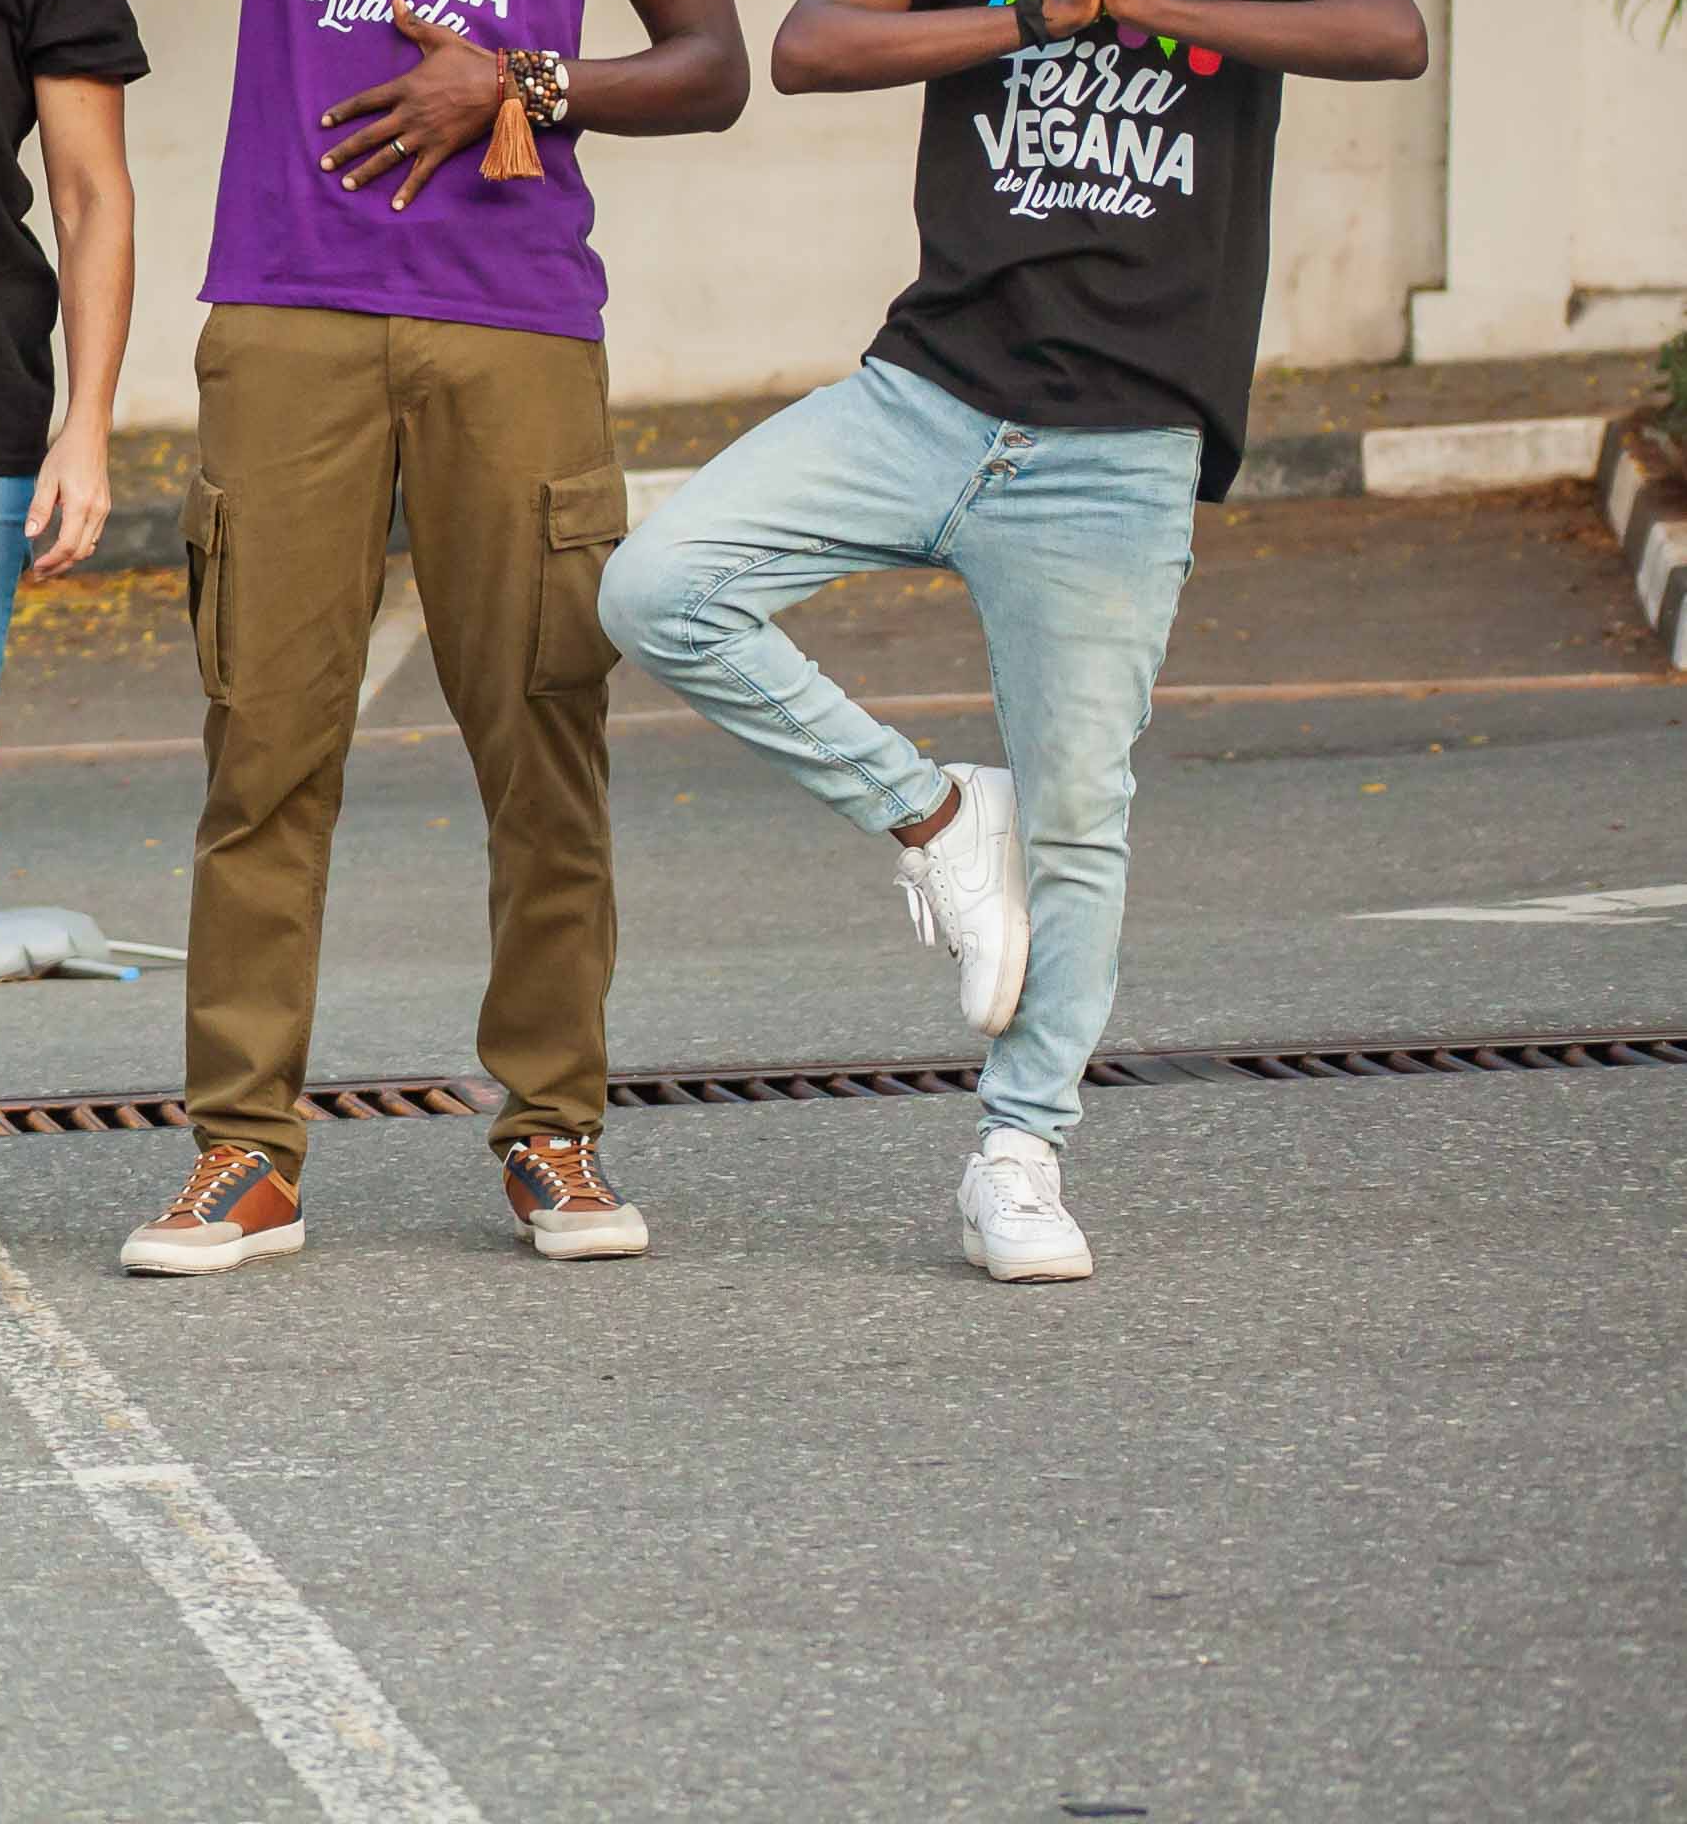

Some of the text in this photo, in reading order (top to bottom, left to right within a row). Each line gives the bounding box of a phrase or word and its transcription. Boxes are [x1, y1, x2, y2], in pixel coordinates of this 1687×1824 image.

[998, 36, 1187, 115] Feira
[973, 107, 1194, 196] VEGANA
[993, 168, 1157, 219] de Luanda
